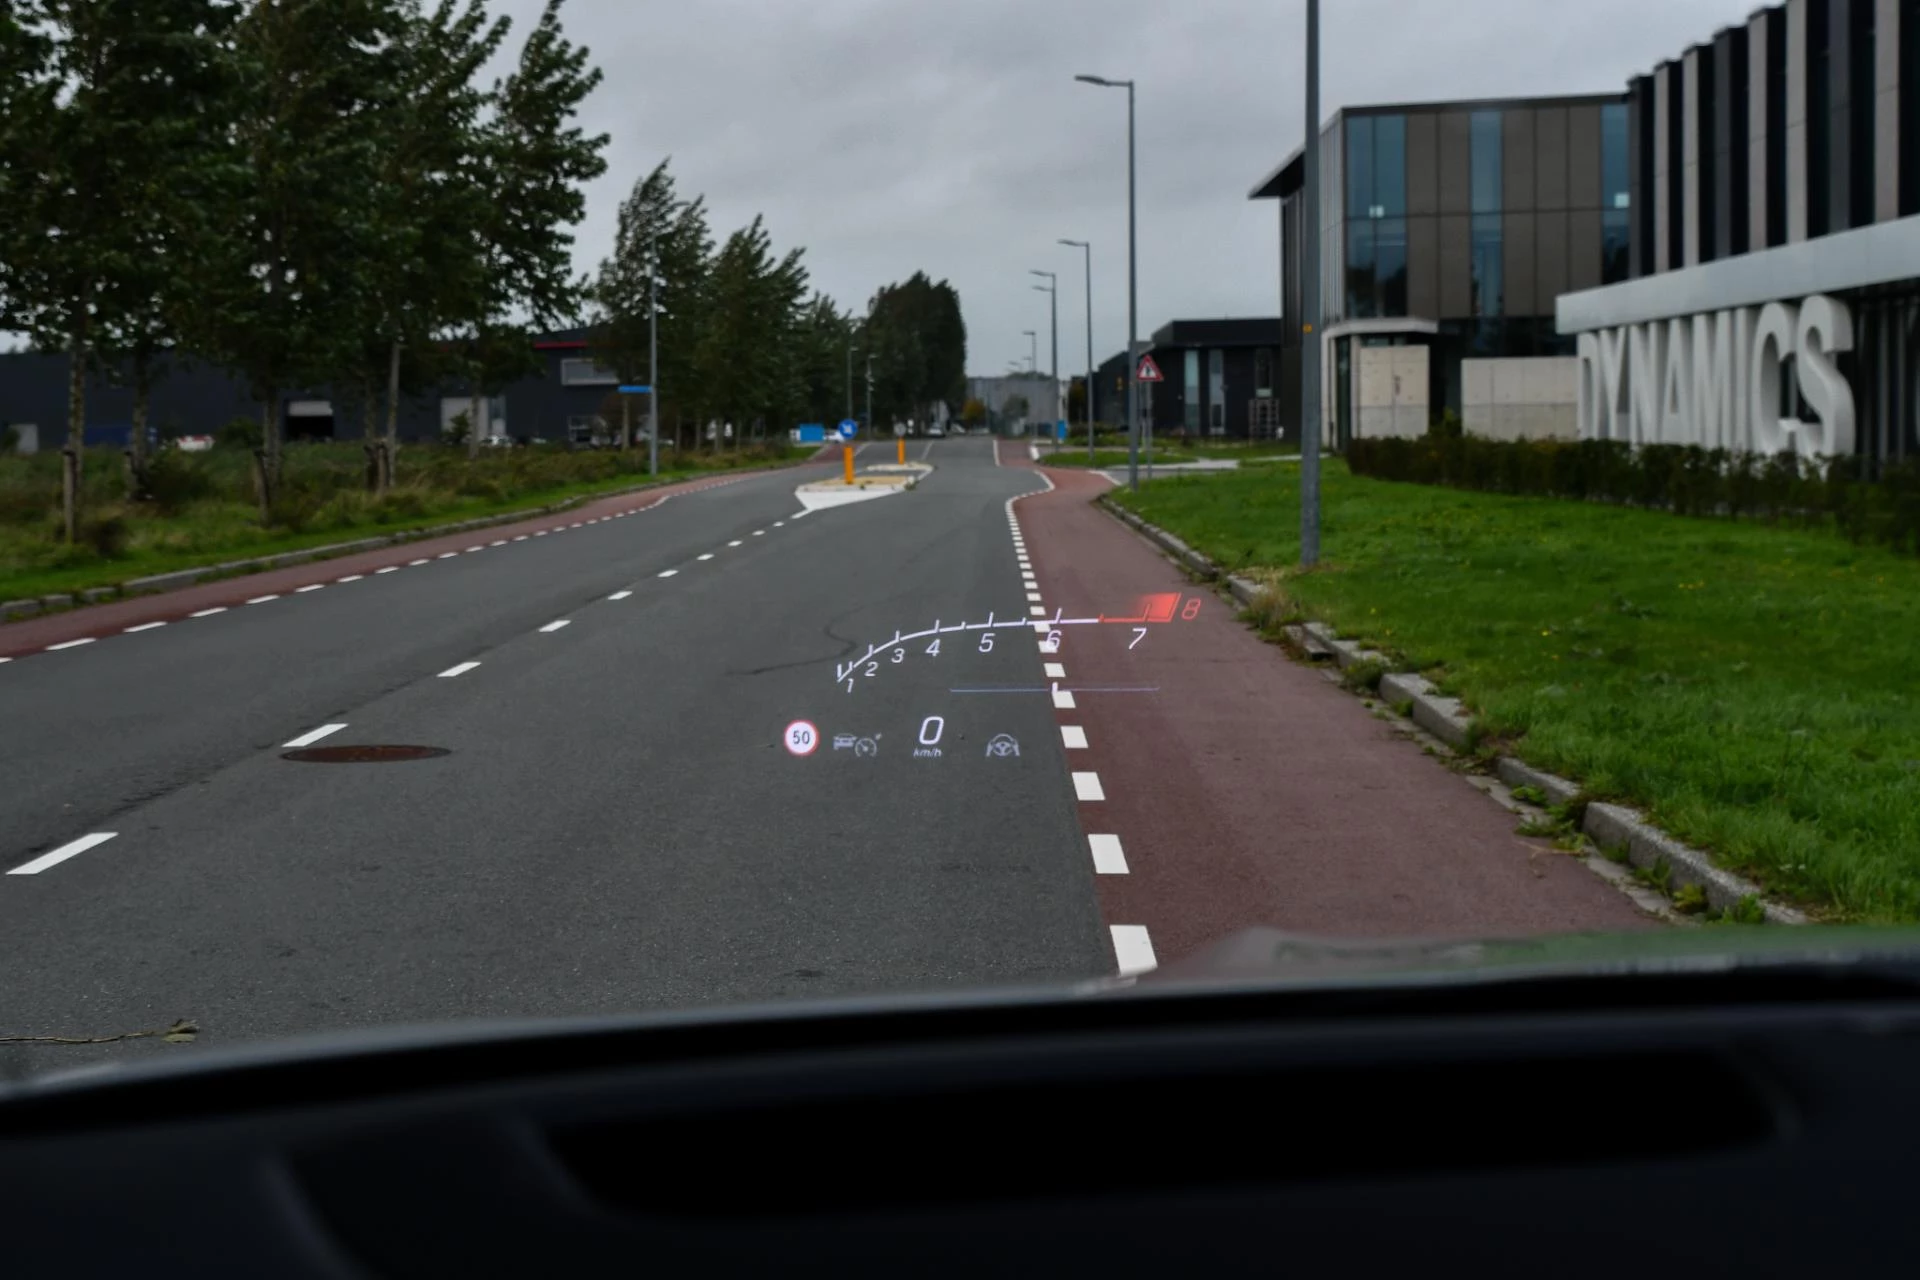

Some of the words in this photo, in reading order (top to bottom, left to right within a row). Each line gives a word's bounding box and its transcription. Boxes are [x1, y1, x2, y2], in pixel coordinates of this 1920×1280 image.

[1577, 294, 1855, 478] DYNAMICS
[847, 678, 854, 693] 1
[864, 661, 879, 677] 2
[892, 648, 905, 663] 3
[926, 639, 941, 657] 4
[978, 632, 995, 653] 5
[1046, 630, 1062, 650] 6
[1129, 628, 1147, 650] 7
[1182, 598, 1201, 620] 8
[793, 730, 810, 745] 50
[919, 716, 944, 745] 0
[913, 748, 942, 758] km/h
